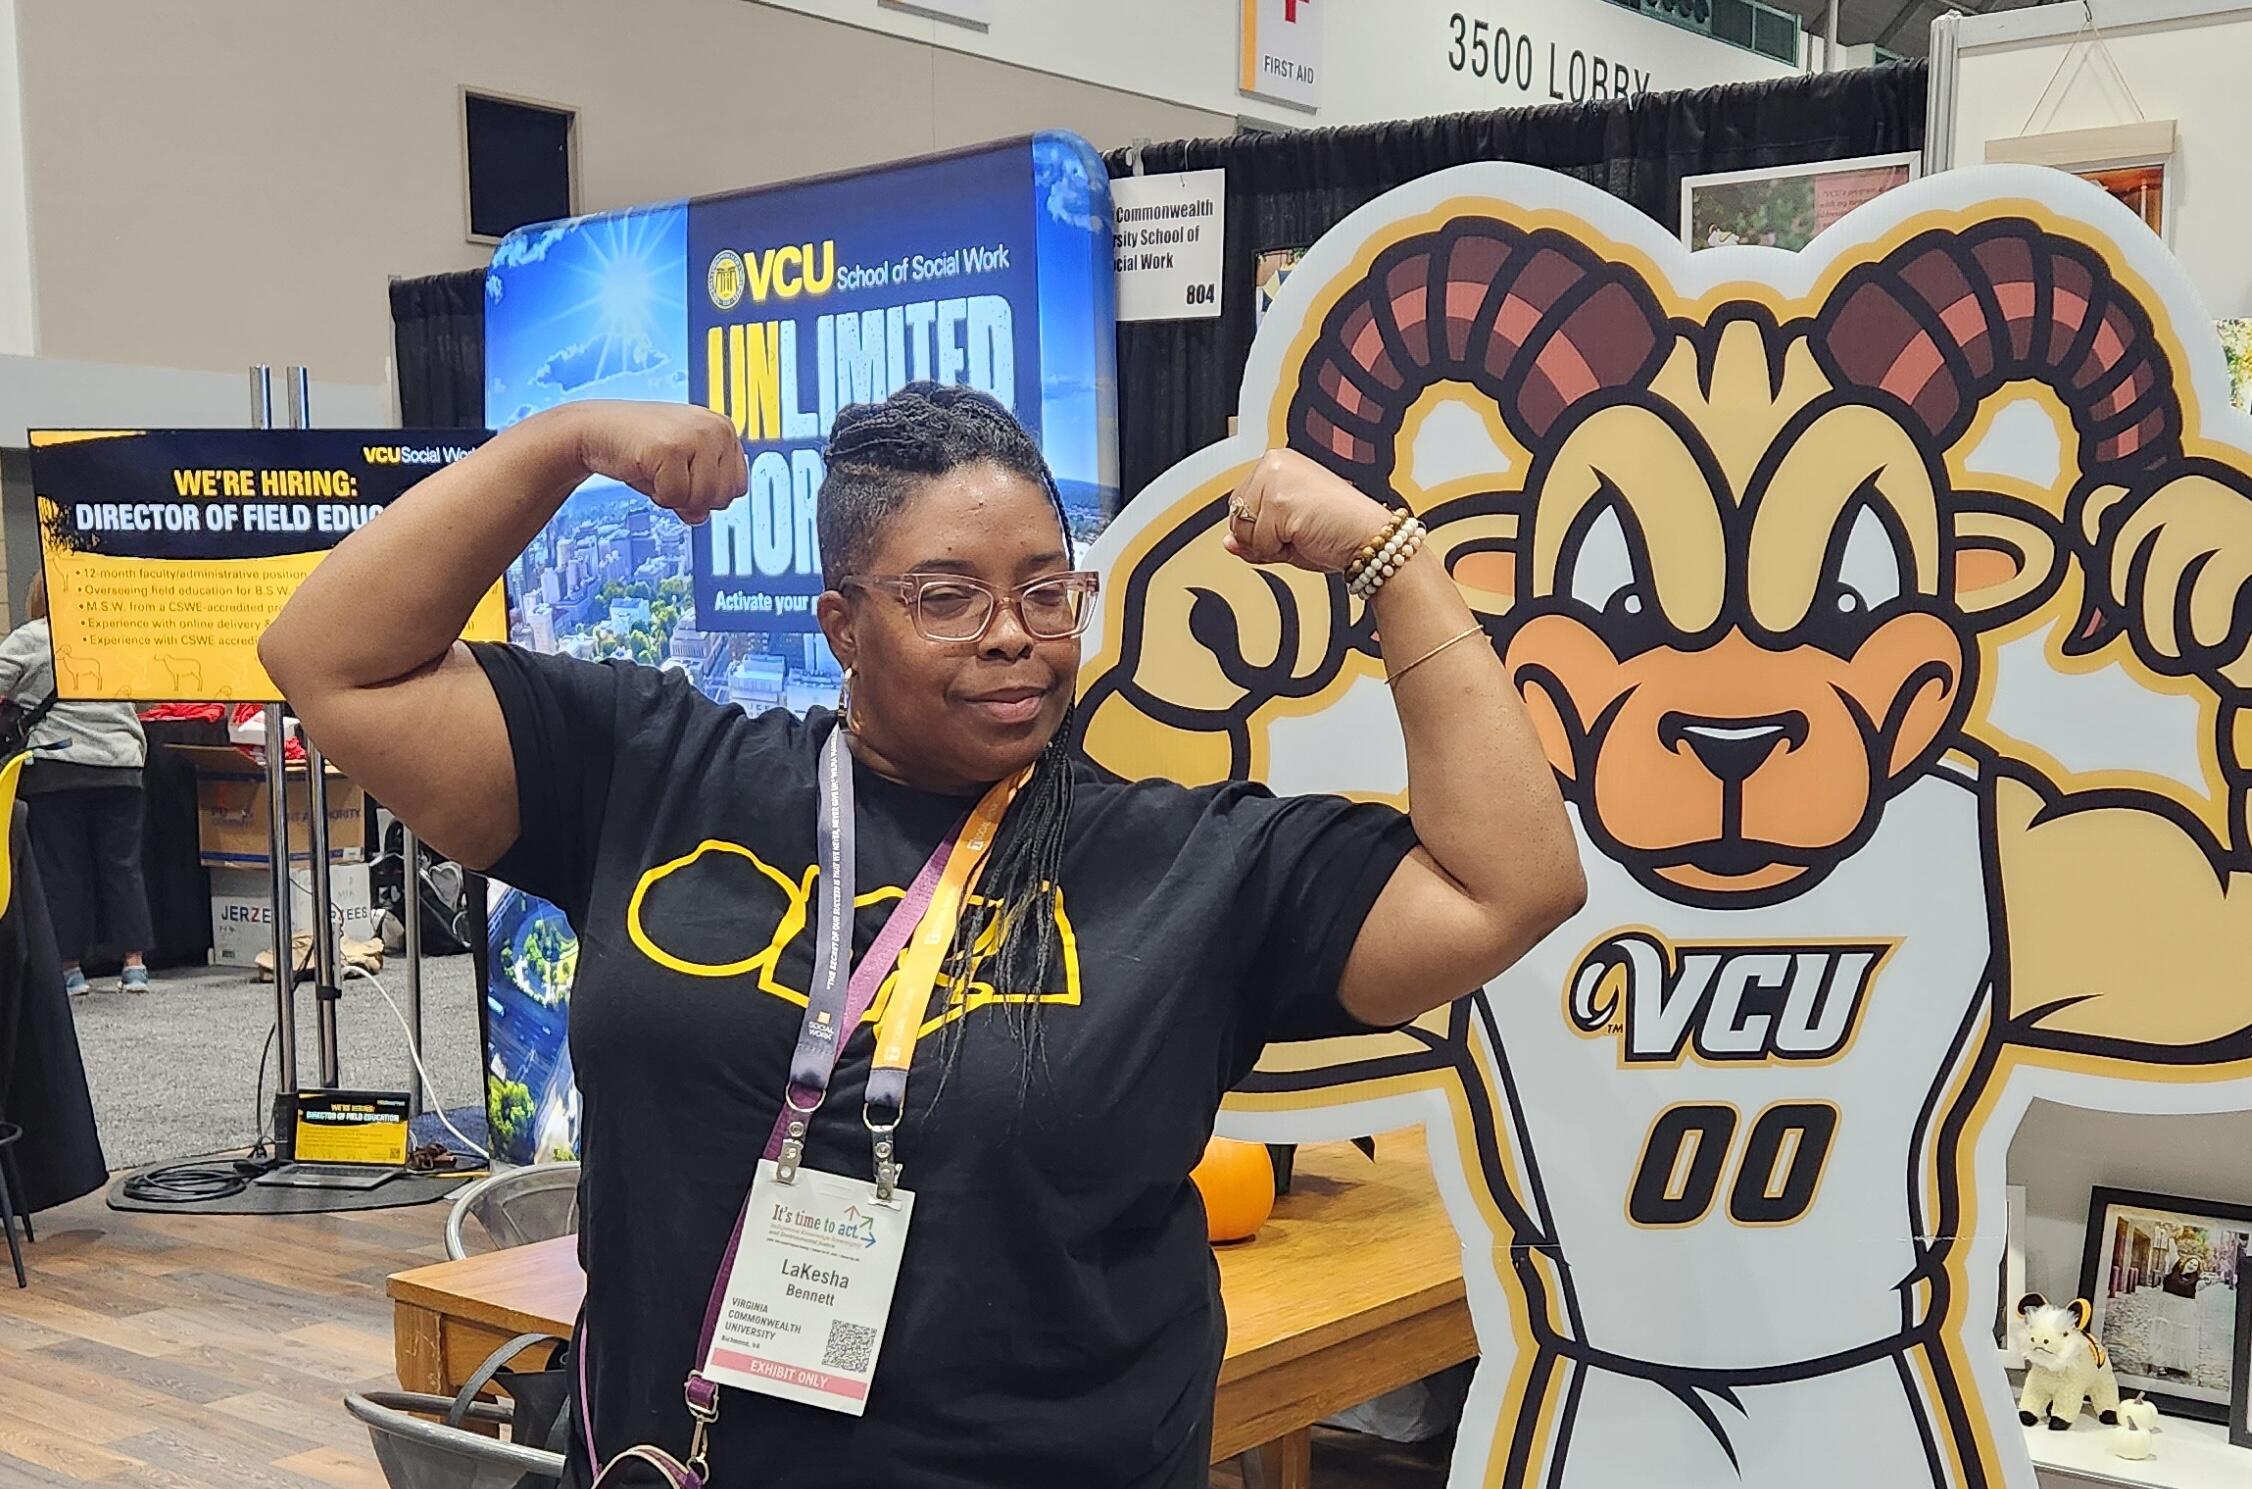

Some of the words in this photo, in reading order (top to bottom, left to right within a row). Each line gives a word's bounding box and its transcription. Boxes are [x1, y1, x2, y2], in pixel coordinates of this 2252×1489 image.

[1448, 13, 1532, 91] 3500
[1264, 55, 1294, 78] FIRST
[1296, 64, 1314, 84] AID
[1116, 199, 1213, 223] Commonwealth
[1140, 226, 1184, 246] School
[1187, 225, 1200, 242] of
[743, 240, 834, 301] VCU
[836, 260, 889, 290] School
[892, 257, 909, 282] of
[912, 250, 960, 281] Social
[963, 243, 1010, 274] Work
[1140, 252, 1174, 270] Work
[1186, 283, 1215, 304] 804
[708, 294, 1014, 440] UNLIMITED
[173, 469, 256, 497] WE'RE
[261, 470, 358, 497] HIRING:
[75, 503, 201, 531] DIRECTOR
[205, 503, 239, 531] OF
[243, 504, 312, 532] FIELD
[139, 567, 260, 580] faculty/administrative
[84, 585, 148, 598] Overseeing
[178, 585, 233, 596] education
[236, 585, 251, 595] for
[714, 590, 773, 611] Activate
[775, 595, 809, 616] your
[130, 602, 156, 612] from
[159, 604, 166, 612] a
[88, 618, 149, 631] Experience
[152, 618, 176, 629] with
[179, 618, 214, 629] online
[217, 619, 261, 631] delivery
[90, 635, 151, 646] Experience
[154, 635, 178, 645] with
[181, 635, 215, 646] CSWE
[1569, 930, 1895, 1062] VCU
[1607, 1023, 1624, 1034] TM
[1627, 1101, 1840, 1227] 00
[771, 1203, 793, 1224] It's
[795, 1209, 821, 1231] time
[823, 1217, 836, 1233] to
[781, 1258, 850, 1289] LaKesha
[732, 1297, 769, 1313] VIRGINIA
[786, 1283, 836, 1307] Bennett
[724, 1322, 777, 1341] UNIVERSITY
[728, 1309, 802, 1334] COMMONWEALTH
[750, 1360, 797, 1383] EXHIBIT
[797, 1371, 829, 1389] ONLY
